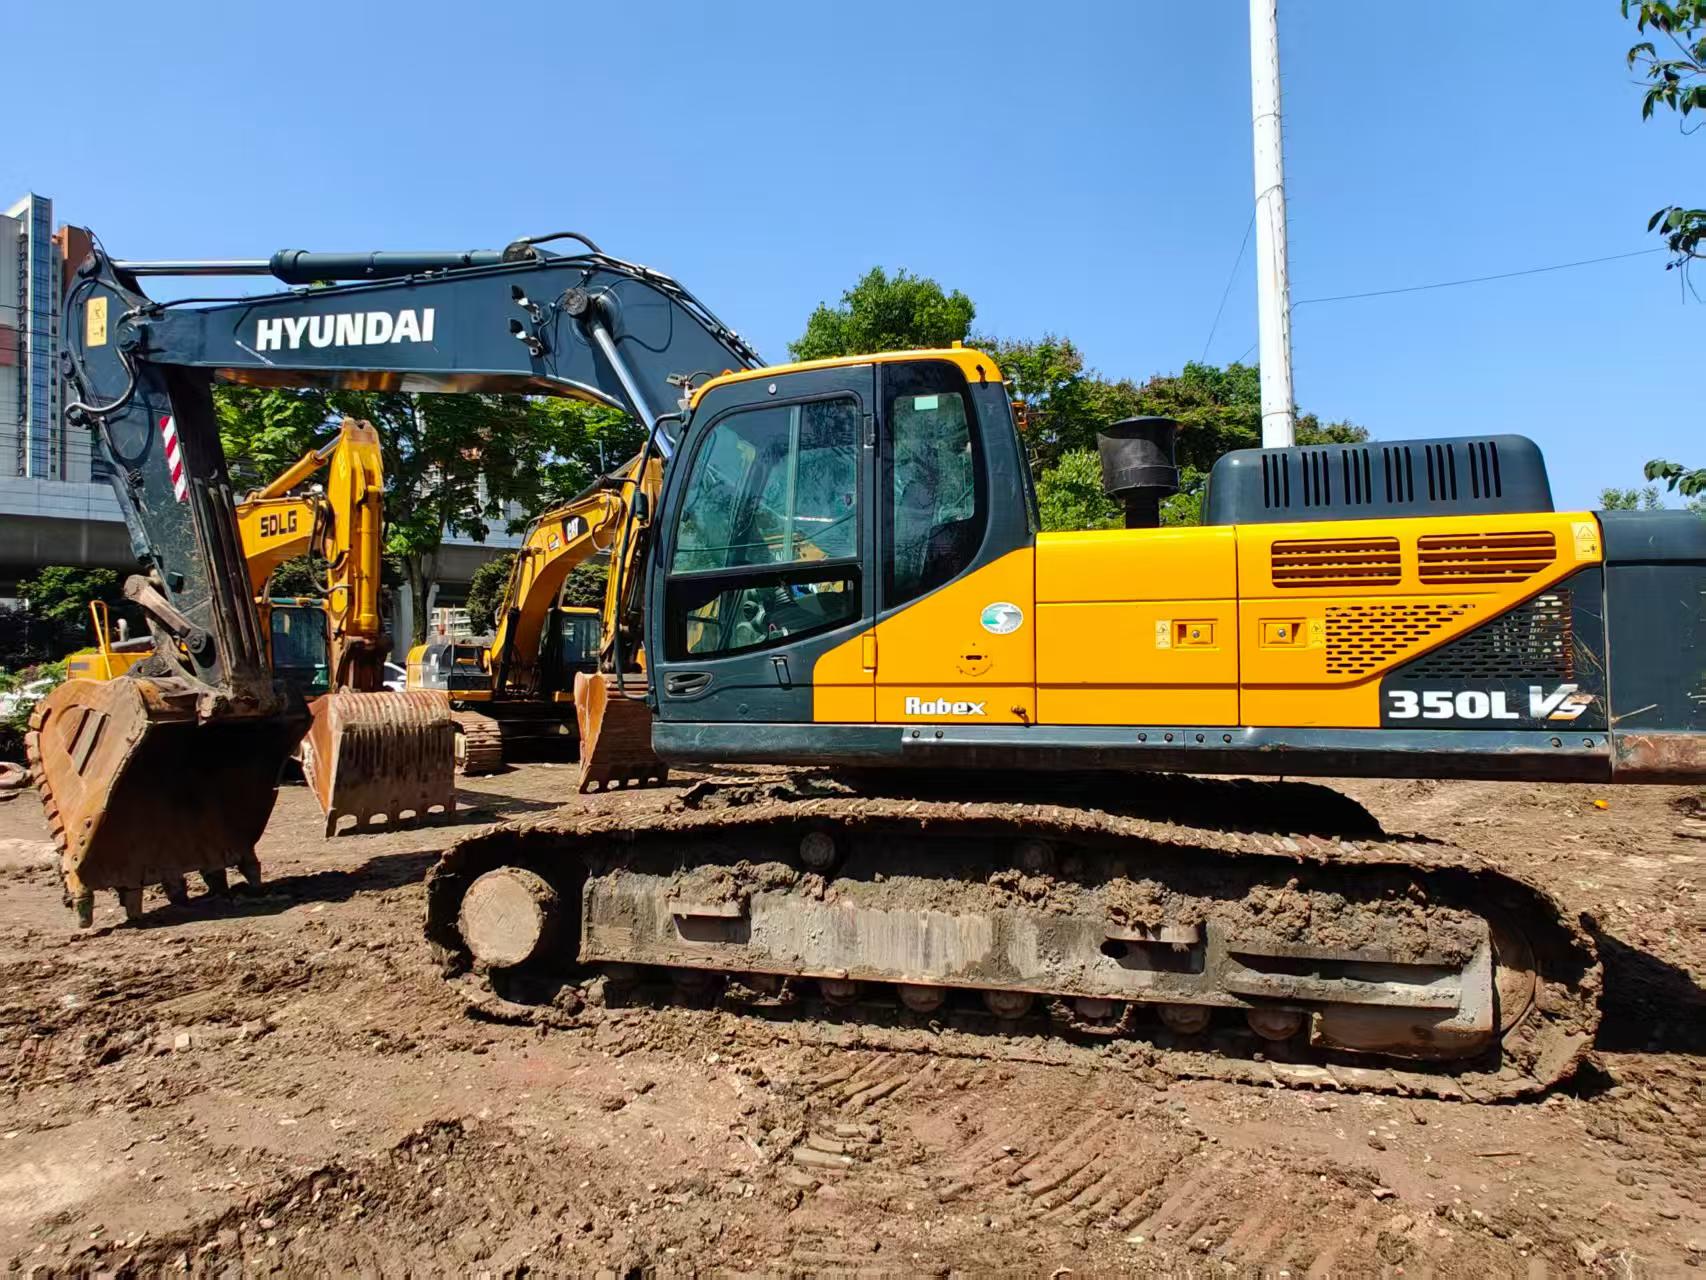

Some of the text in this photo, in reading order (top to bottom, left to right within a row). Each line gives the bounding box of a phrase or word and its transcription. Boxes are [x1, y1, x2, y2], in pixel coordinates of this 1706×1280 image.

[256, 308, 435, 351] HYUNDAI
[260, 510, 297, 537] SDLG
[905, 696, 987, 716] Robex
[1388, 690, 1519, 719] 350L
